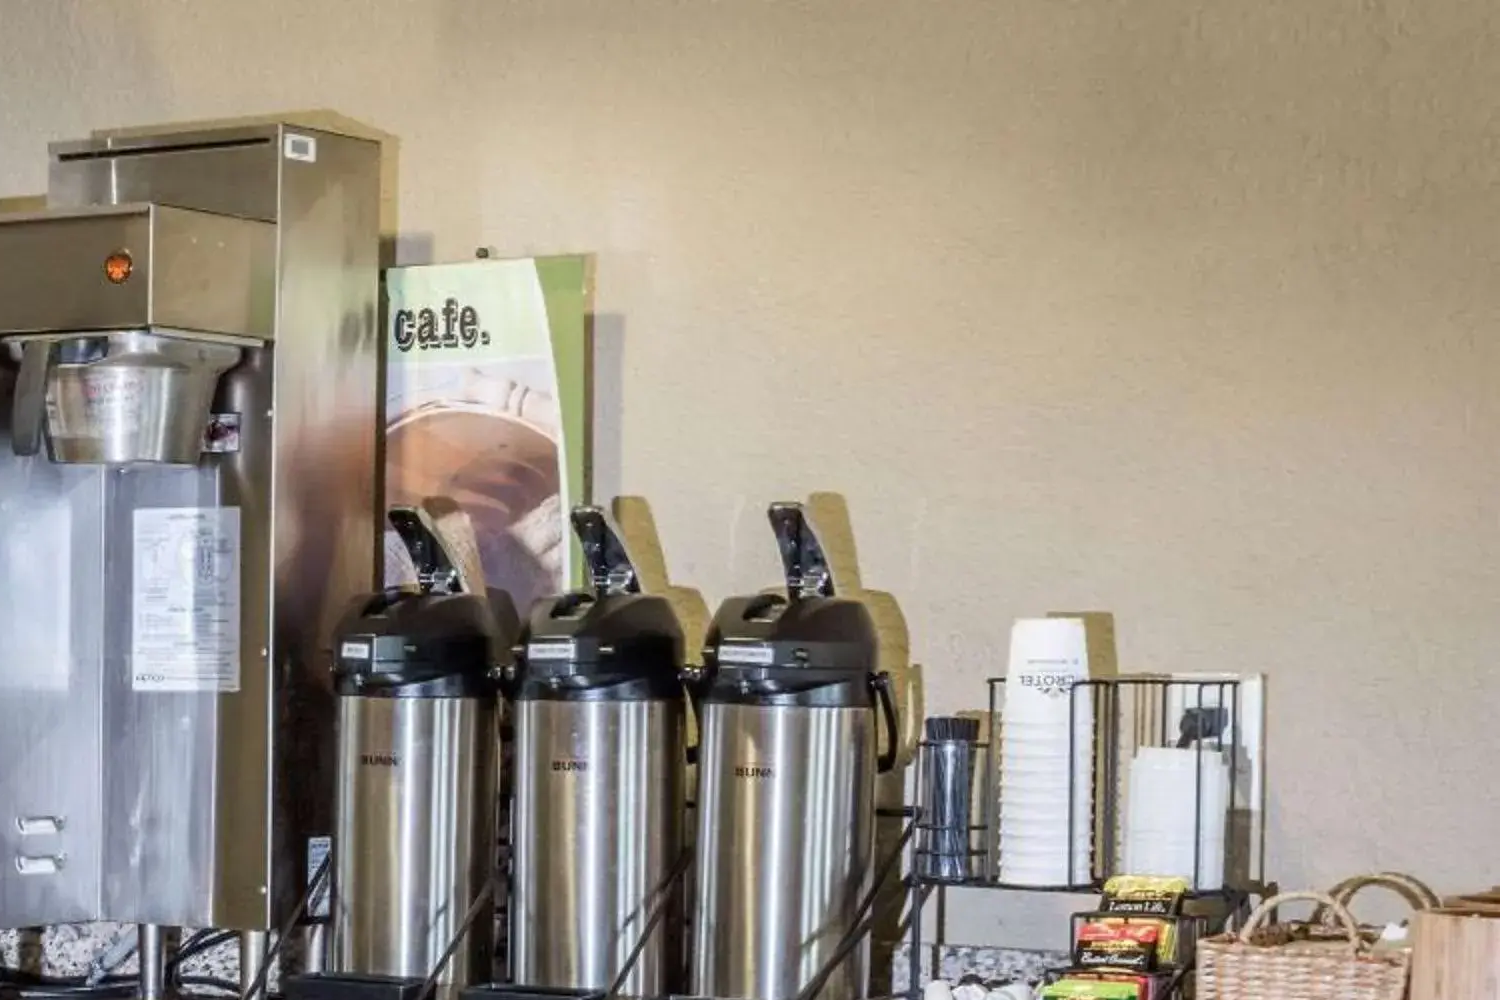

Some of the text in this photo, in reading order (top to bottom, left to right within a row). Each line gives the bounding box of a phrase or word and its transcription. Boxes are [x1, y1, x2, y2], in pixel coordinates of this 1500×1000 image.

[395, 297, 490, 352] cafe.
[361, 754, 398, 766] BUNN
[552, 761, 587, 771] BUNN
[735, 767, 771, 778] BUNN
